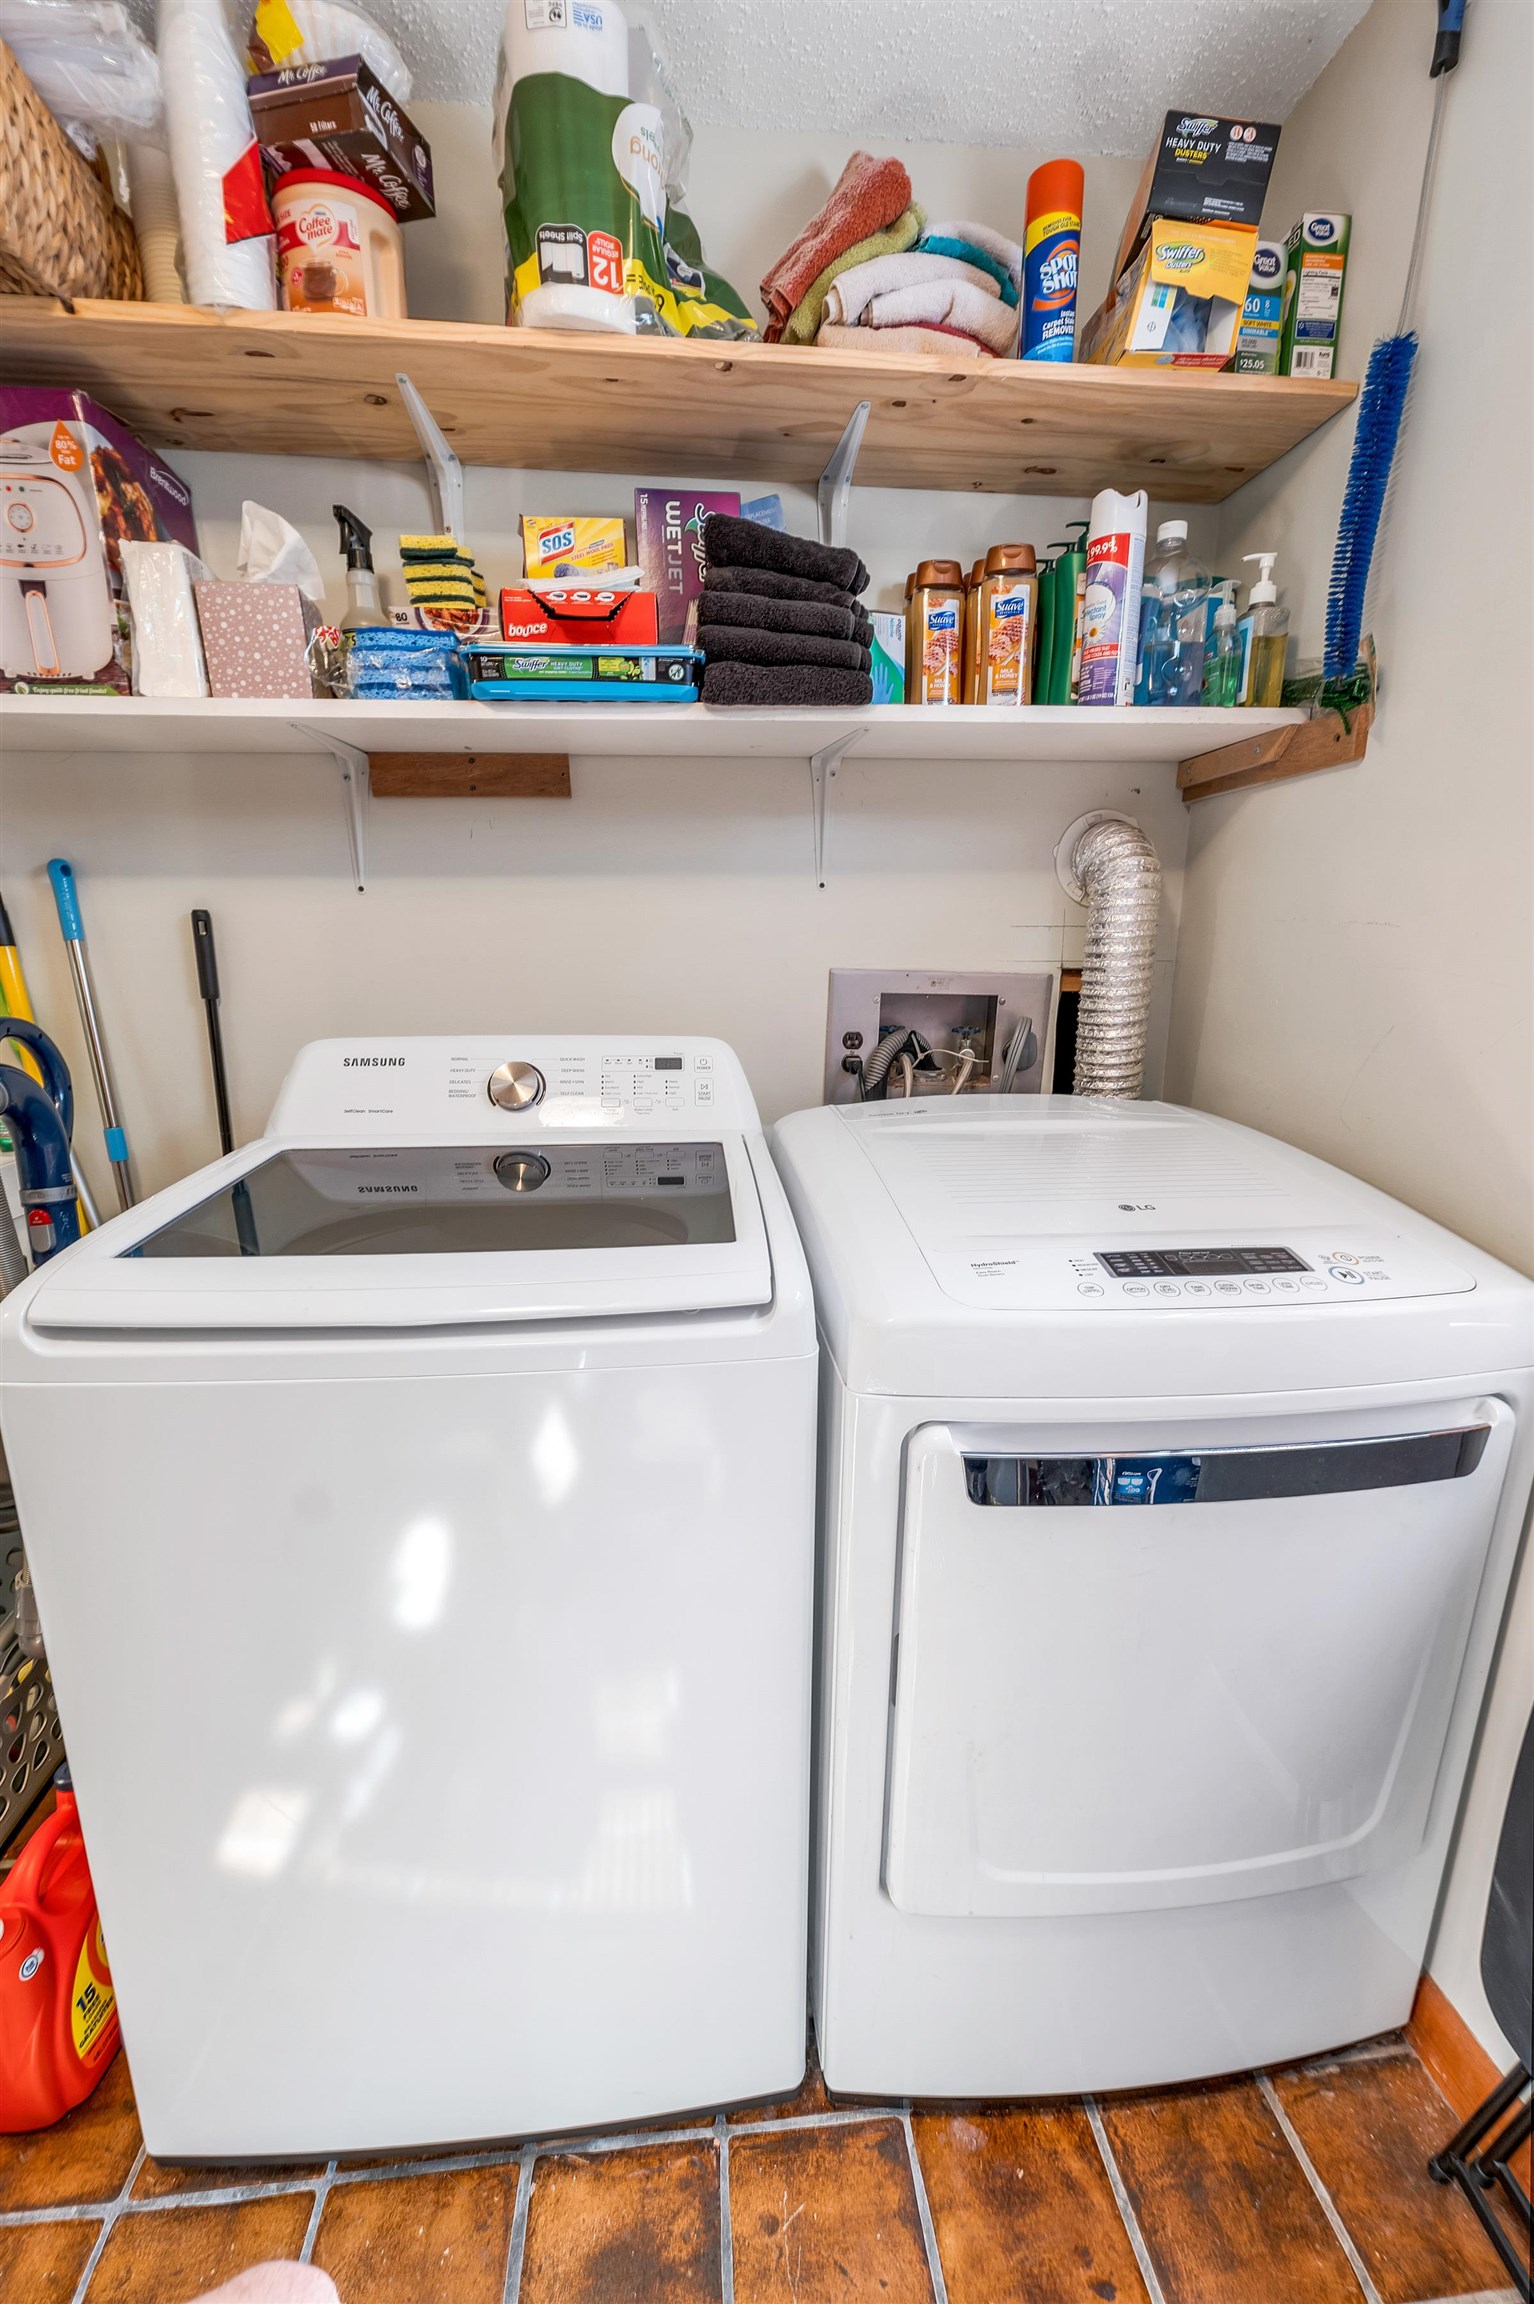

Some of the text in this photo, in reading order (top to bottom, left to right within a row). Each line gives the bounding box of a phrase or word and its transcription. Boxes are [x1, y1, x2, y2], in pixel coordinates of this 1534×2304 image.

[583, 12, 603, 26] USA
[295, 63, 328, 83] Coffee
[380, 101, 405, 141] Coffee
[1176, 117, 1219, 138] Swiffer
[1165, 136, 1197, 149] HEAVY
[1197, 141, 1222, 154] DUTY
[1174, 148, 1208, 160] DUSTERS
[378, 174, 410, 211] Coffee
[299, 215, 331, 234] Coffee
[1310, 221, 1331, 233] Great
[307, 225, 333, 241] mate
[538, 230, 583, 243] Split Sheets
[1315, 229, 1331, 237] Value
[1156, 244, 1204, 261] Swiffer
[1040, 254, 1078, 280] SPOT
[1254, 254, 1276, 267] Great
[592, 255, 620, 290] 12
[1258, 263, 1276, 273] Value
[1043, 271, 1078, 295] SHOT
[1245, 297, 1270, 313] 60 8
[1042, 316, 1064, 331] Carpet
[1243, 319, 1272, 328] SOFT WHITE
[1239, 358, 1265, 370] $25.05
[55, 439, 77, 450] 80%
[57, 454, 77, 465] Fat
[150, 466, 189, 506] Brentwood
[640, 492, 648, 504] 15
[570, 552, 585, 562] STEEL
[585, 547, 601, 557] WOOL
[1090, 541, 1118, 558] 99.9%
[996, 600, 1023, 612] Suave
[395, 612, 408, 622] 80
[929, 614, 954, 625] Suave
[1088, 611, 1107, 623] Spray
[509, 622, 548, 638] bounce
[512, 657, 549, 671] Swiffer
[343, 1057, 406, 1067] SAMSUNG
[1137, 1203, 1157, 1212] LG
[76, 1982, 97, 2009] 15
